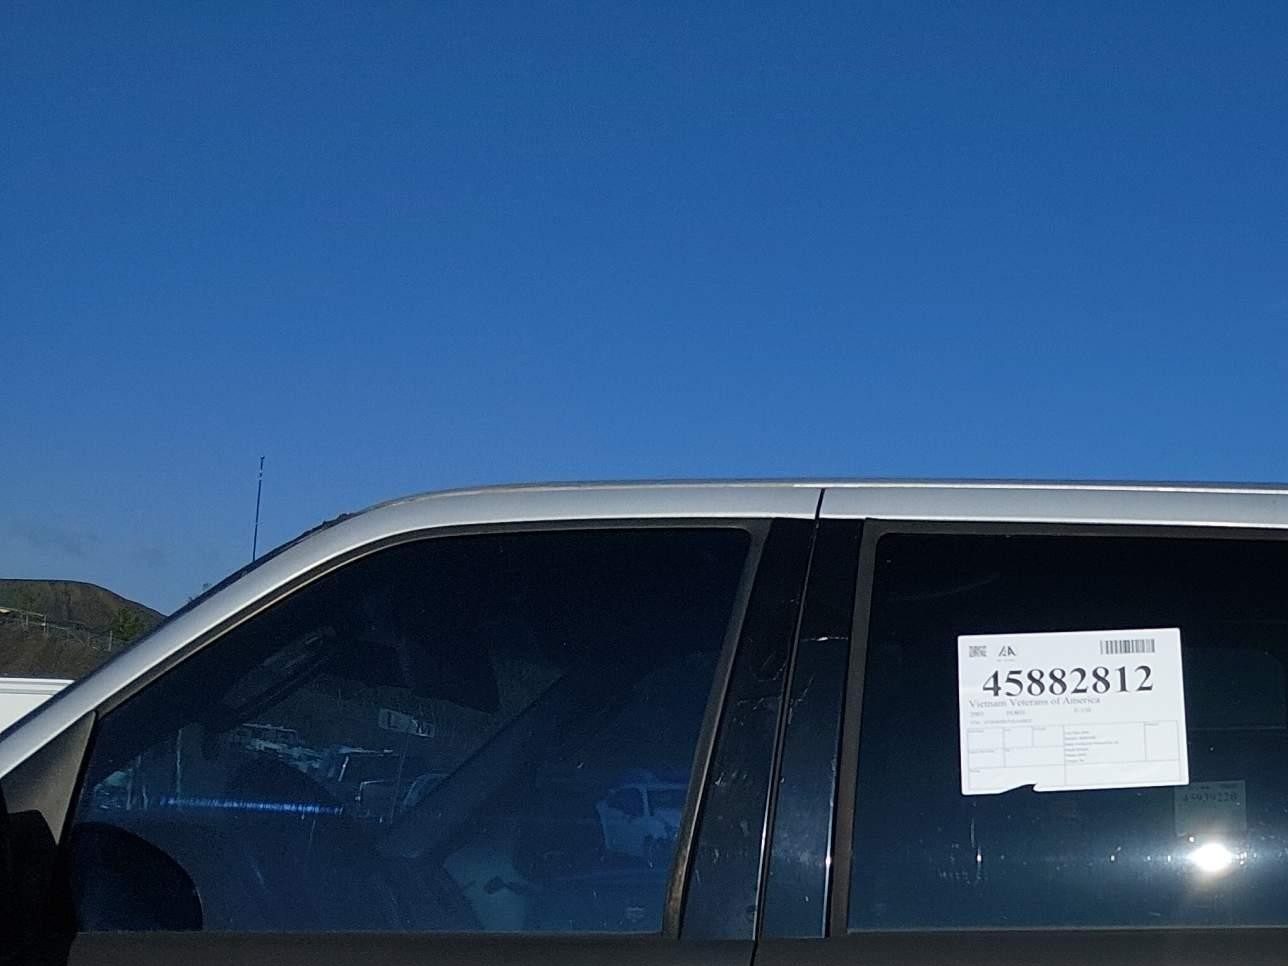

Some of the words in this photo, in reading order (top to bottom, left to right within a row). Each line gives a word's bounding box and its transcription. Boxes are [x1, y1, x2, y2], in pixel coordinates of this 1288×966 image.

[982, 665, 1153, 697] 45882812
[1050, 696, 1060, 705] of
[1062, 696, 1101, 705] America
